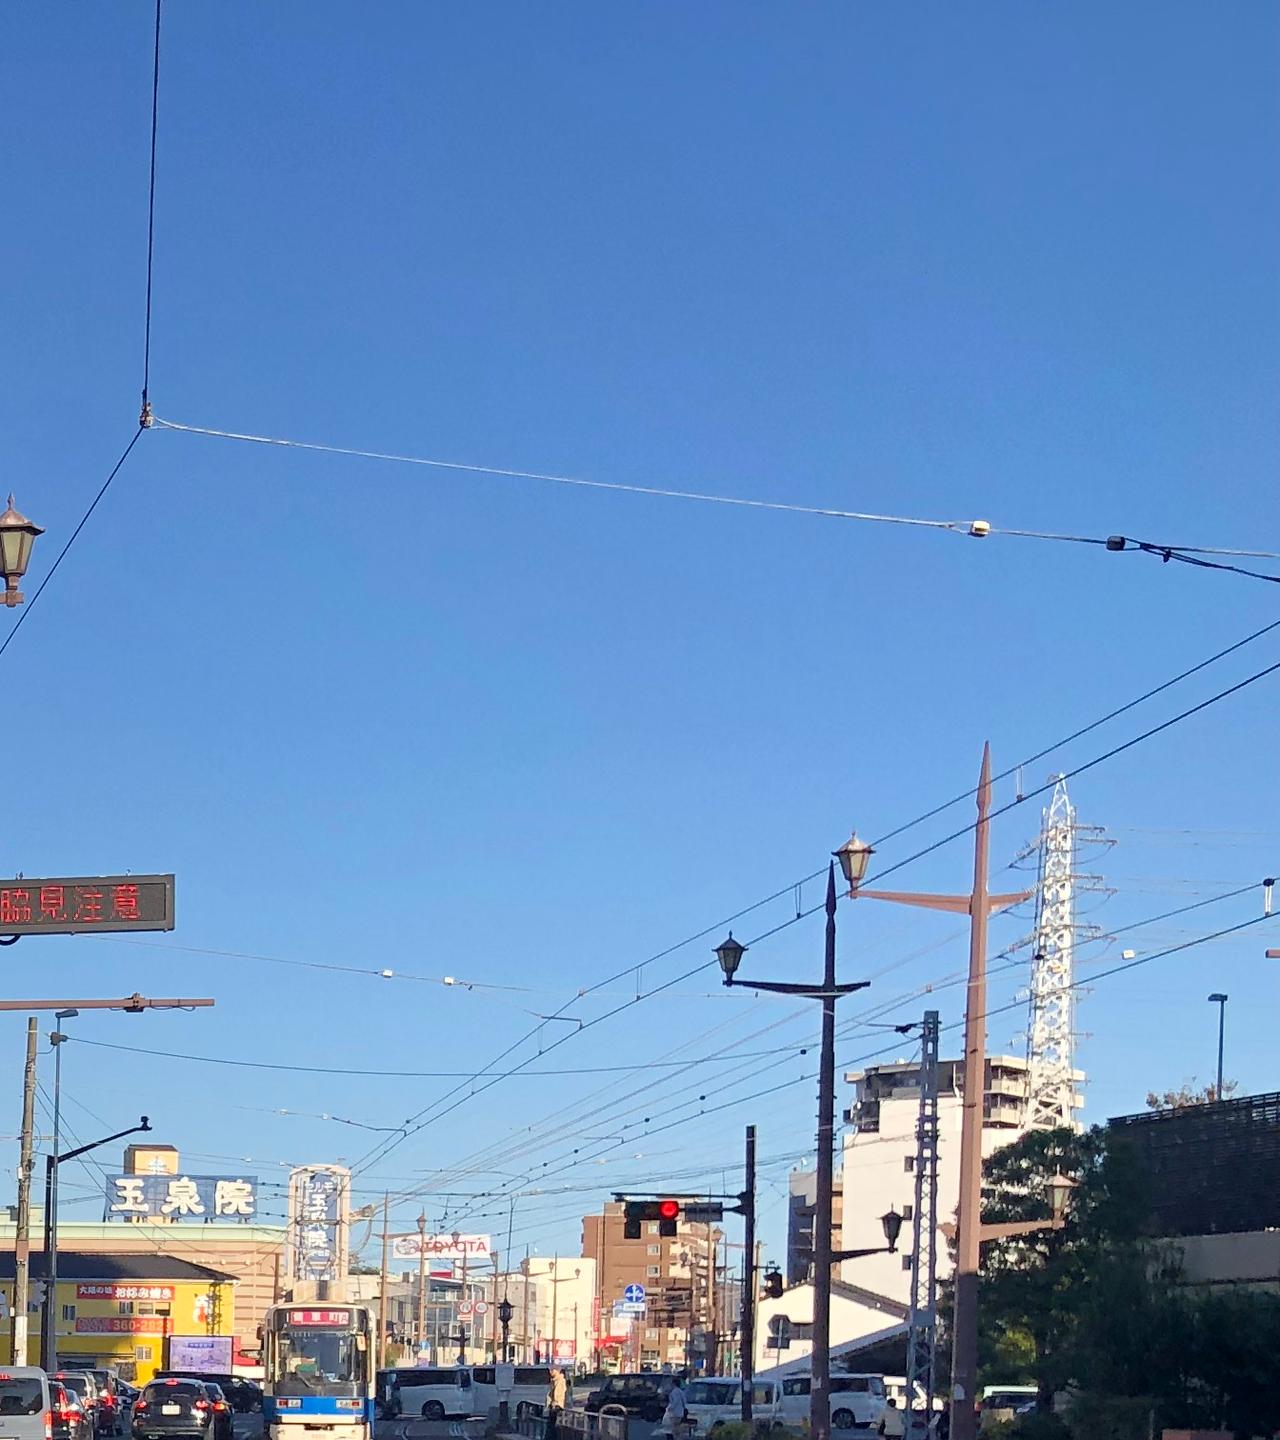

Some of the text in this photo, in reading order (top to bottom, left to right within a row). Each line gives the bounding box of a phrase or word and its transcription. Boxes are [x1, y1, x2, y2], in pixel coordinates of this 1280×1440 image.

[0, 884, 141, 923] 脇見注意
[110, 1176, 255, 1215] 玉泉院
[424, 1240, 487, 1253] TOYOTA
[115, 1286, 173, 1299] お好み焼き
